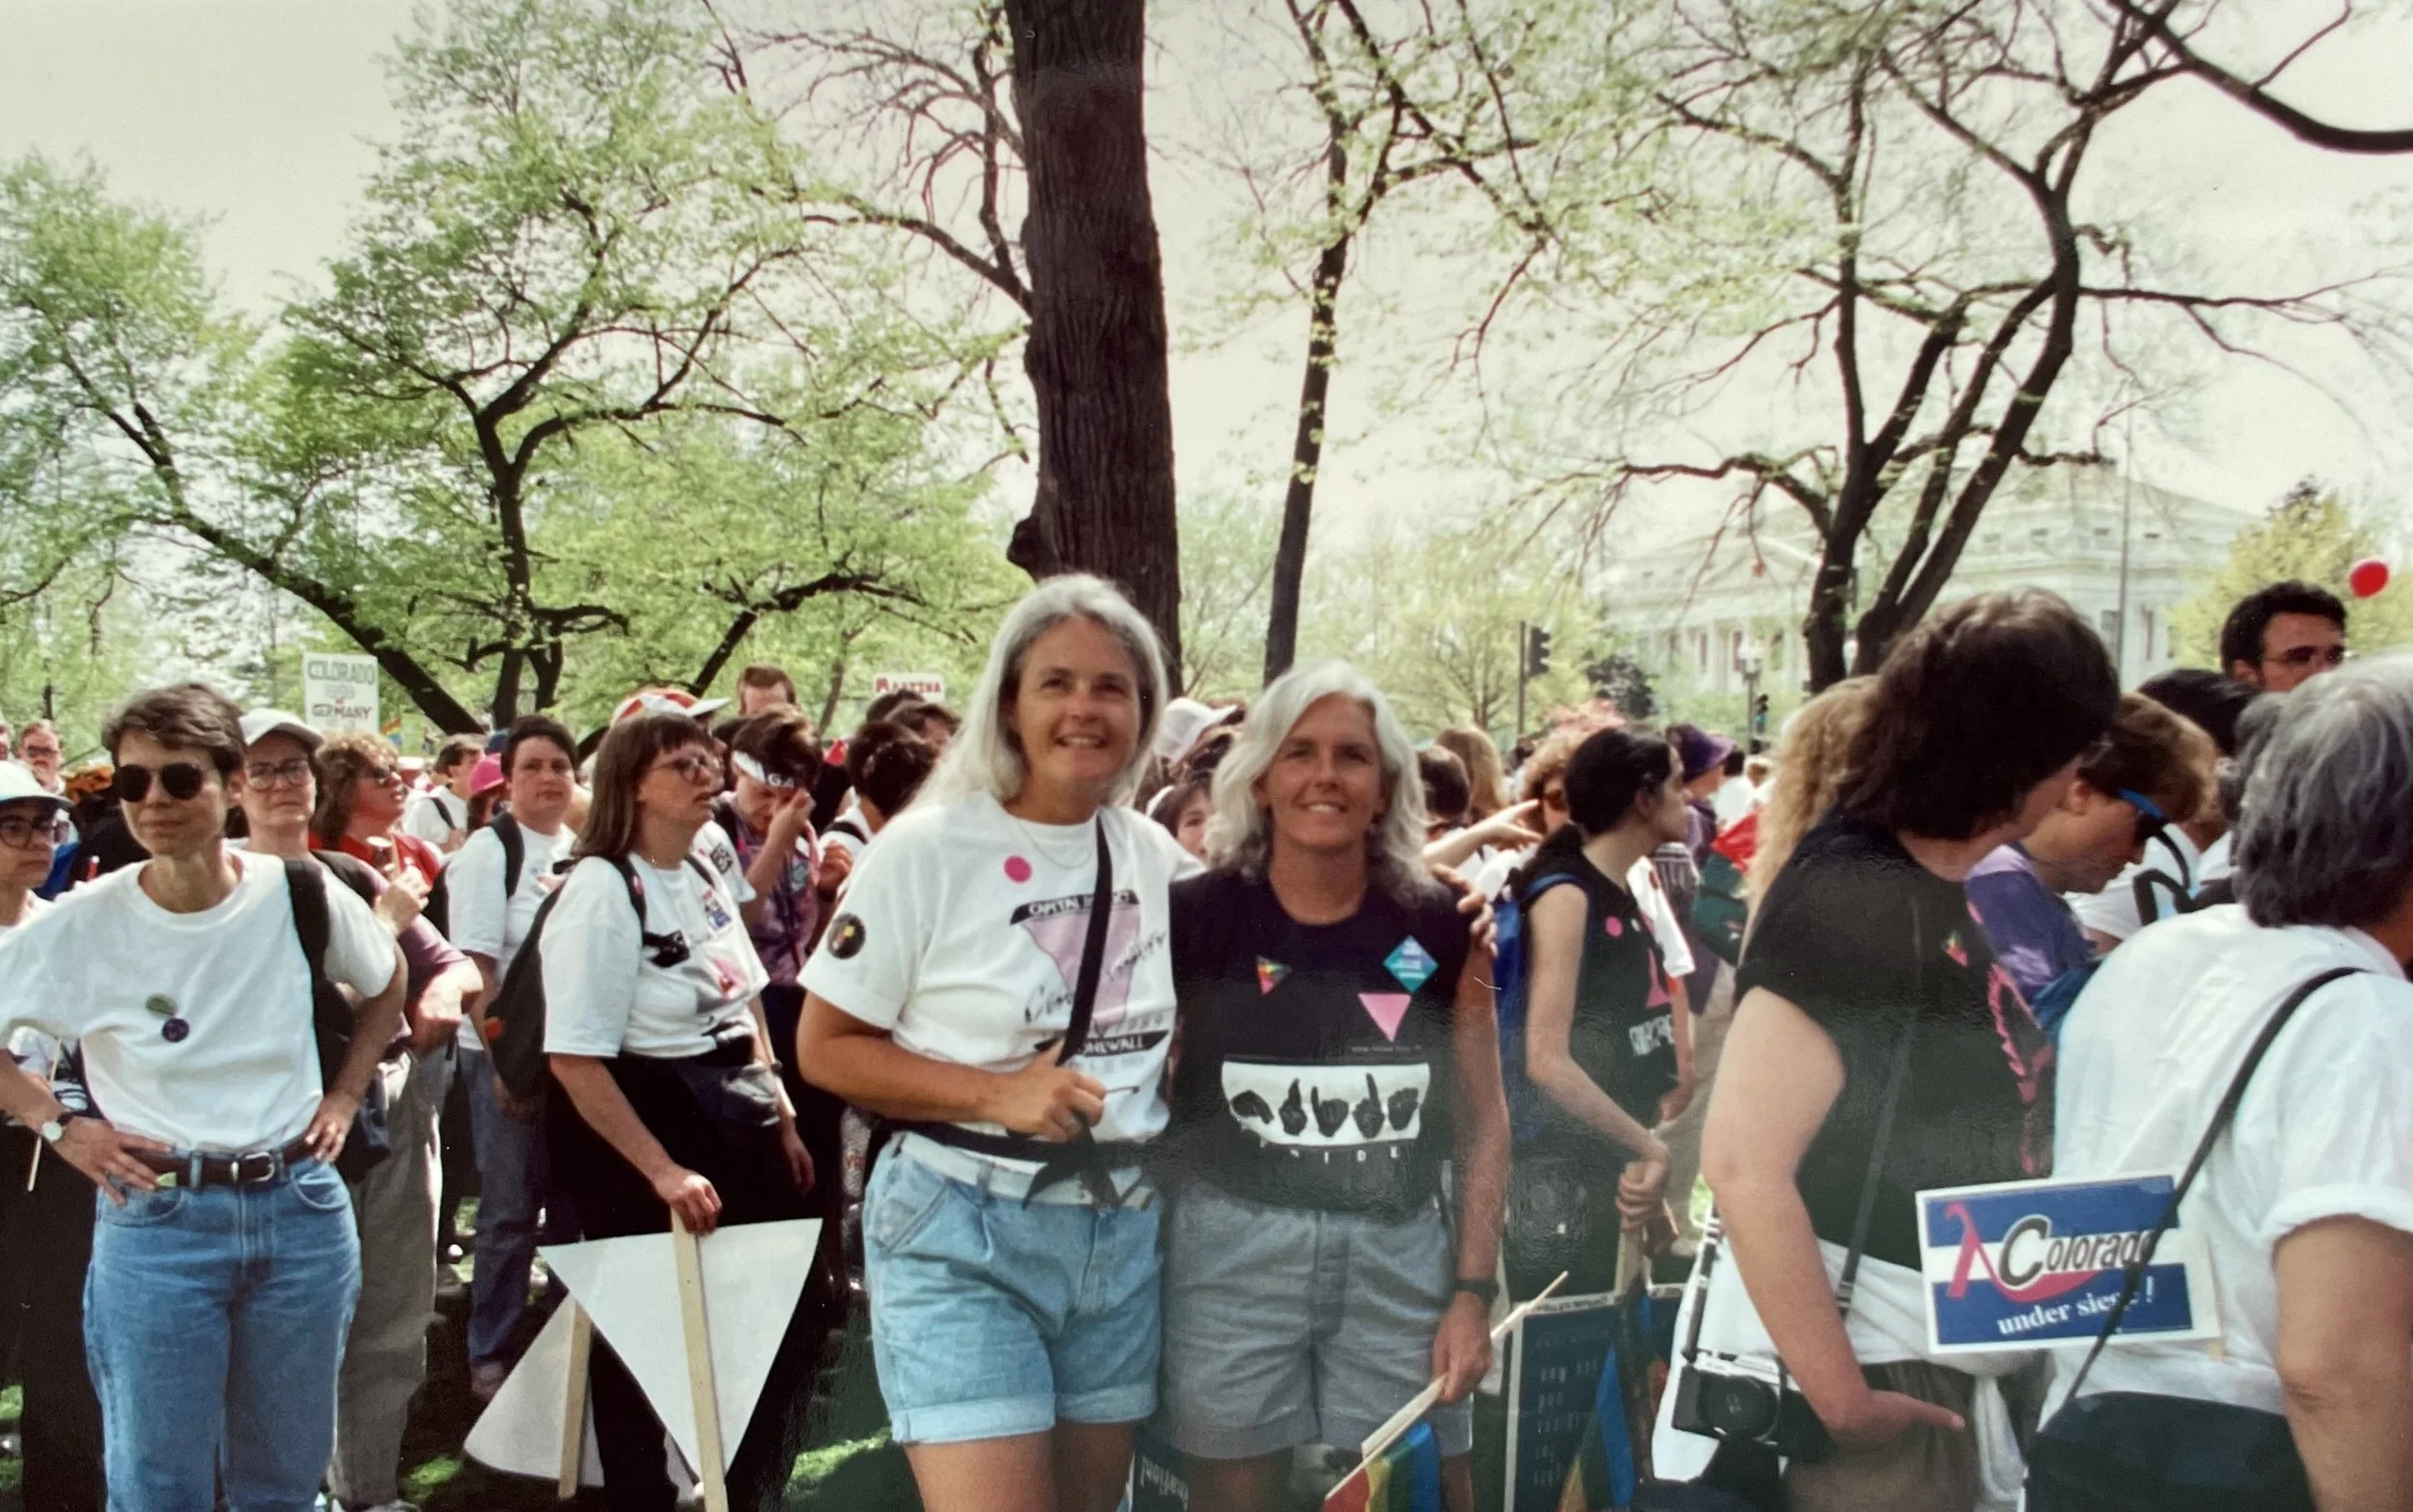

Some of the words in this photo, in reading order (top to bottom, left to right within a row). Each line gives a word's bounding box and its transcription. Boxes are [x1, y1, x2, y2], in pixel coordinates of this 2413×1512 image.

[308, 659, 376, 685] COLORADO
[312, 702, 373, 720] GERMANY
[1996, 1304, 2072, 1335] under
